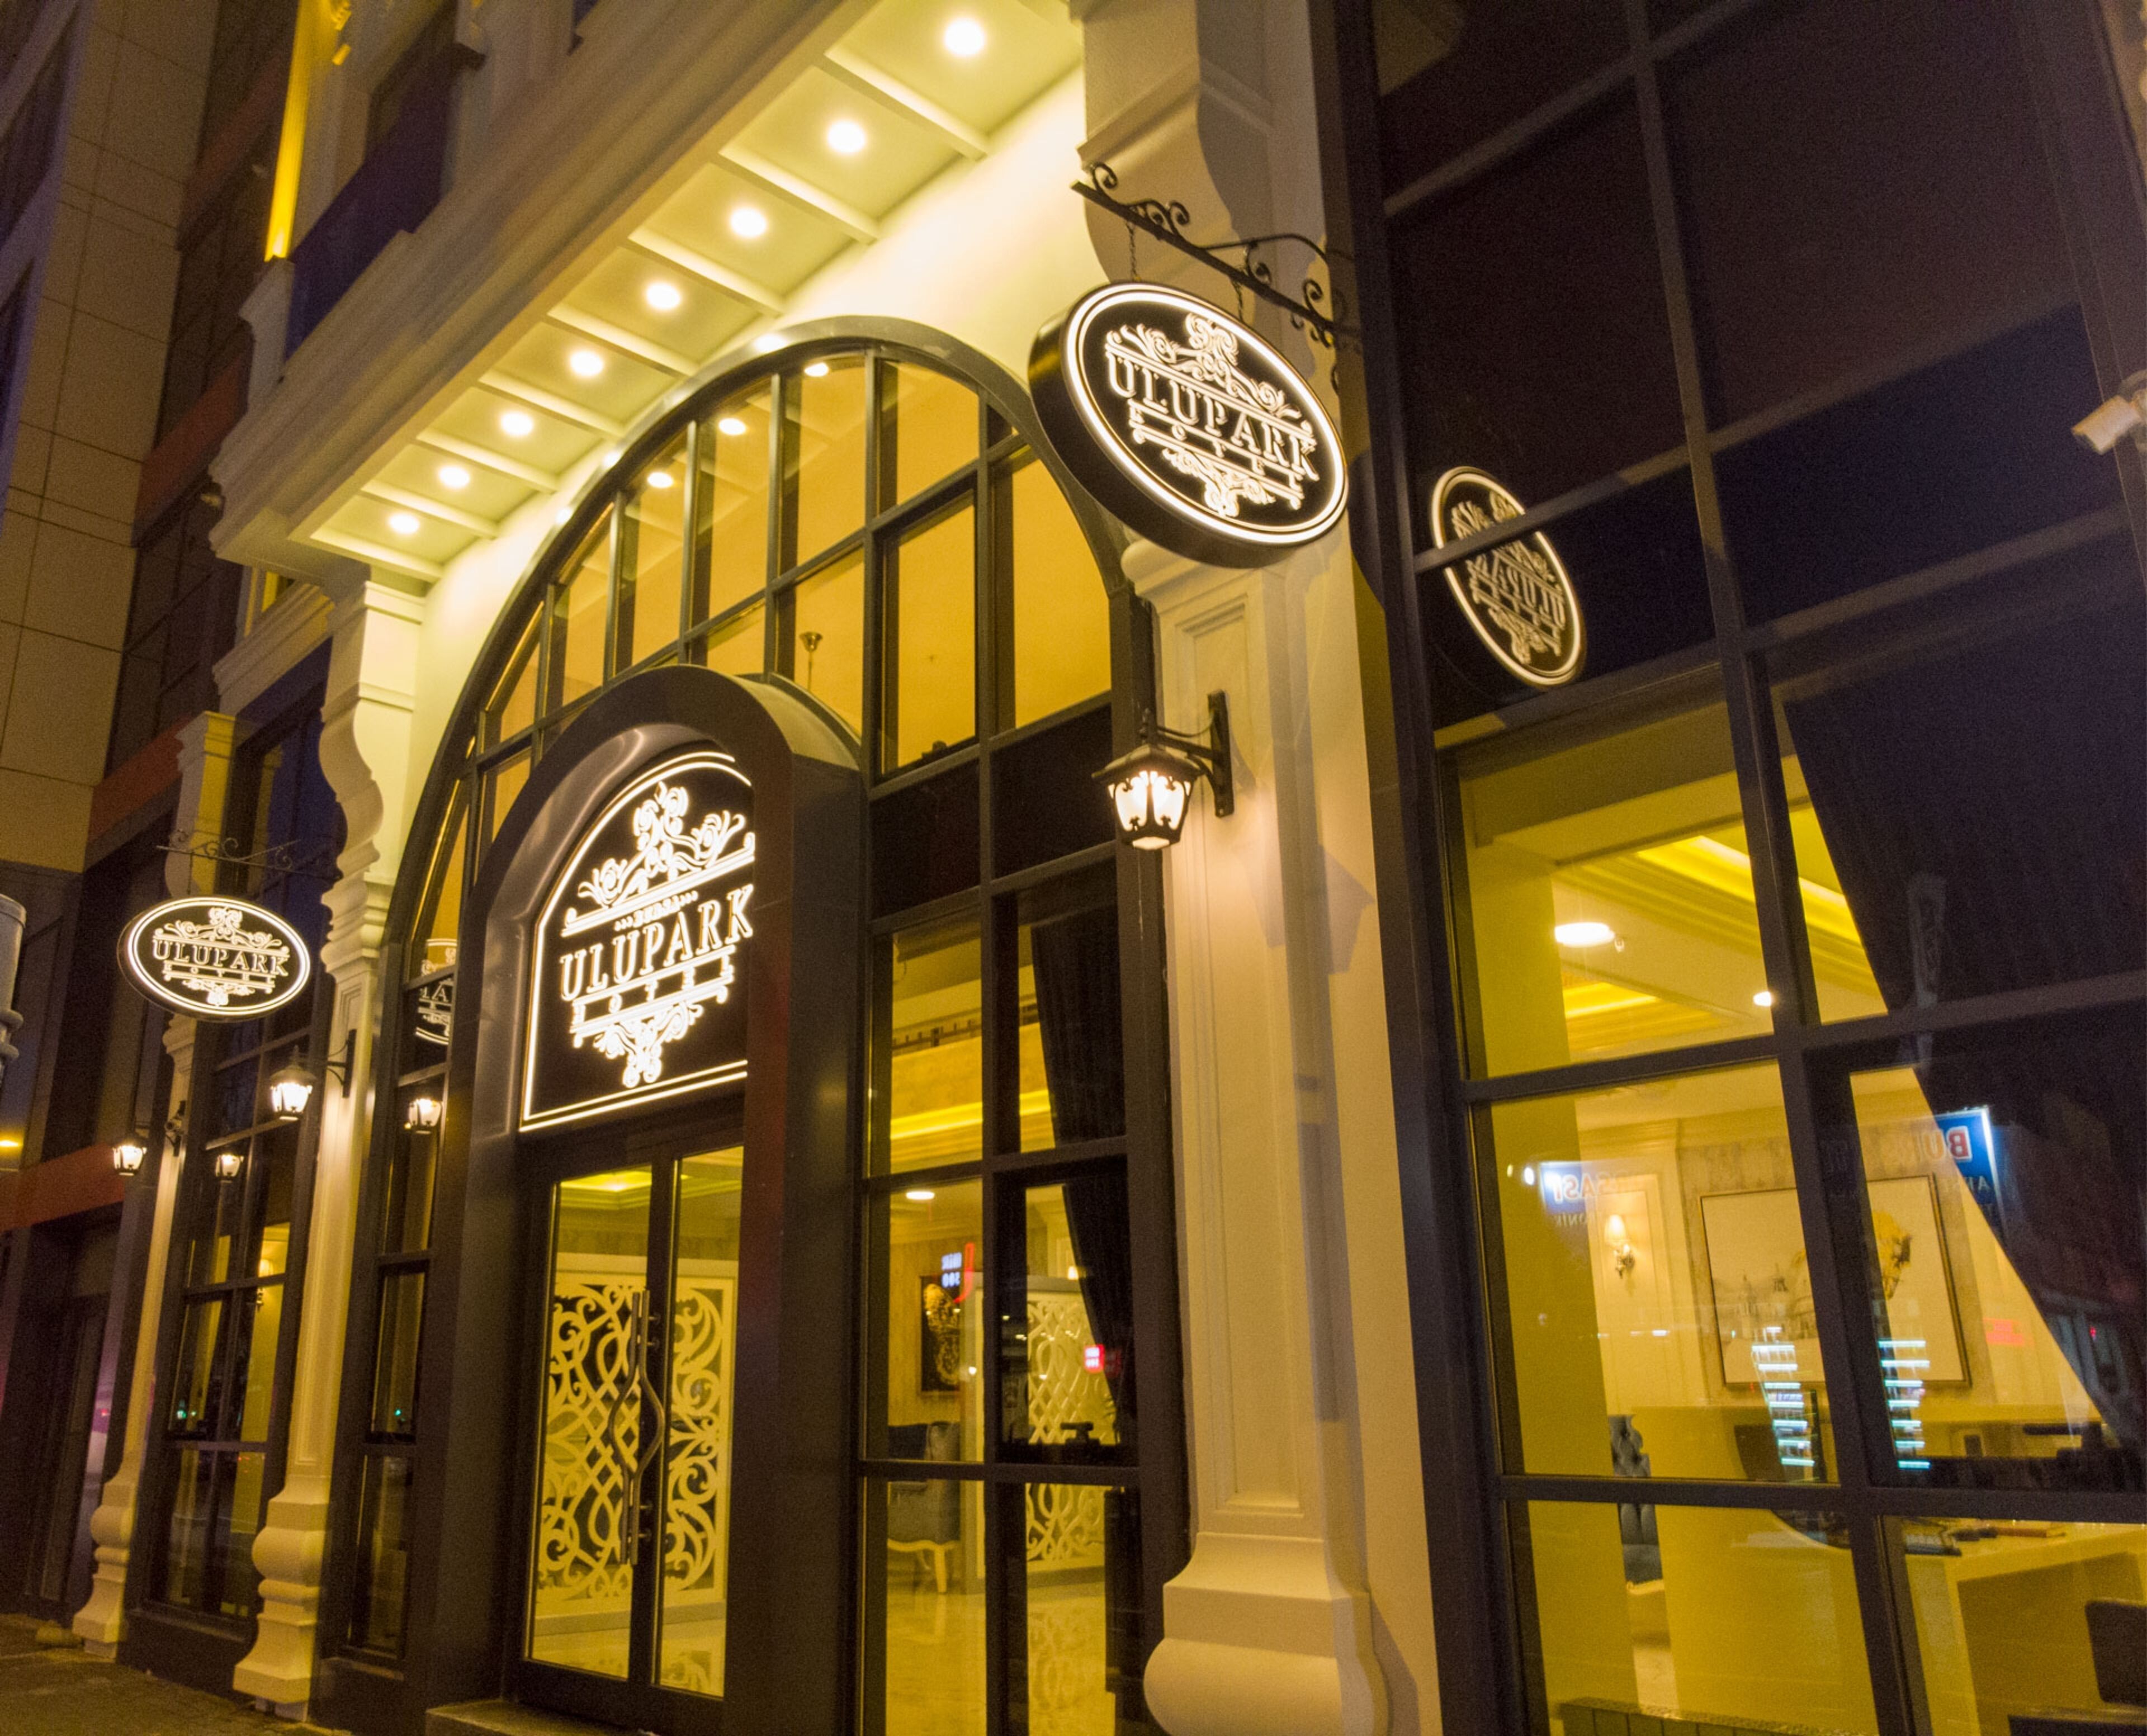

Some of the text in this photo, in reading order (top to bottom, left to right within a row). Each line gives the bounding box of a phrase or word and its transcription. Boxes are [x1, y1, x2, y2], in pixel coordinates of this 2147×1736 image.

[1106, 352, 1320, 481] ULUPARK
[153, 939, 289, 977] ULUPARK
[560, 884, 754, 1001] ULUPARK
